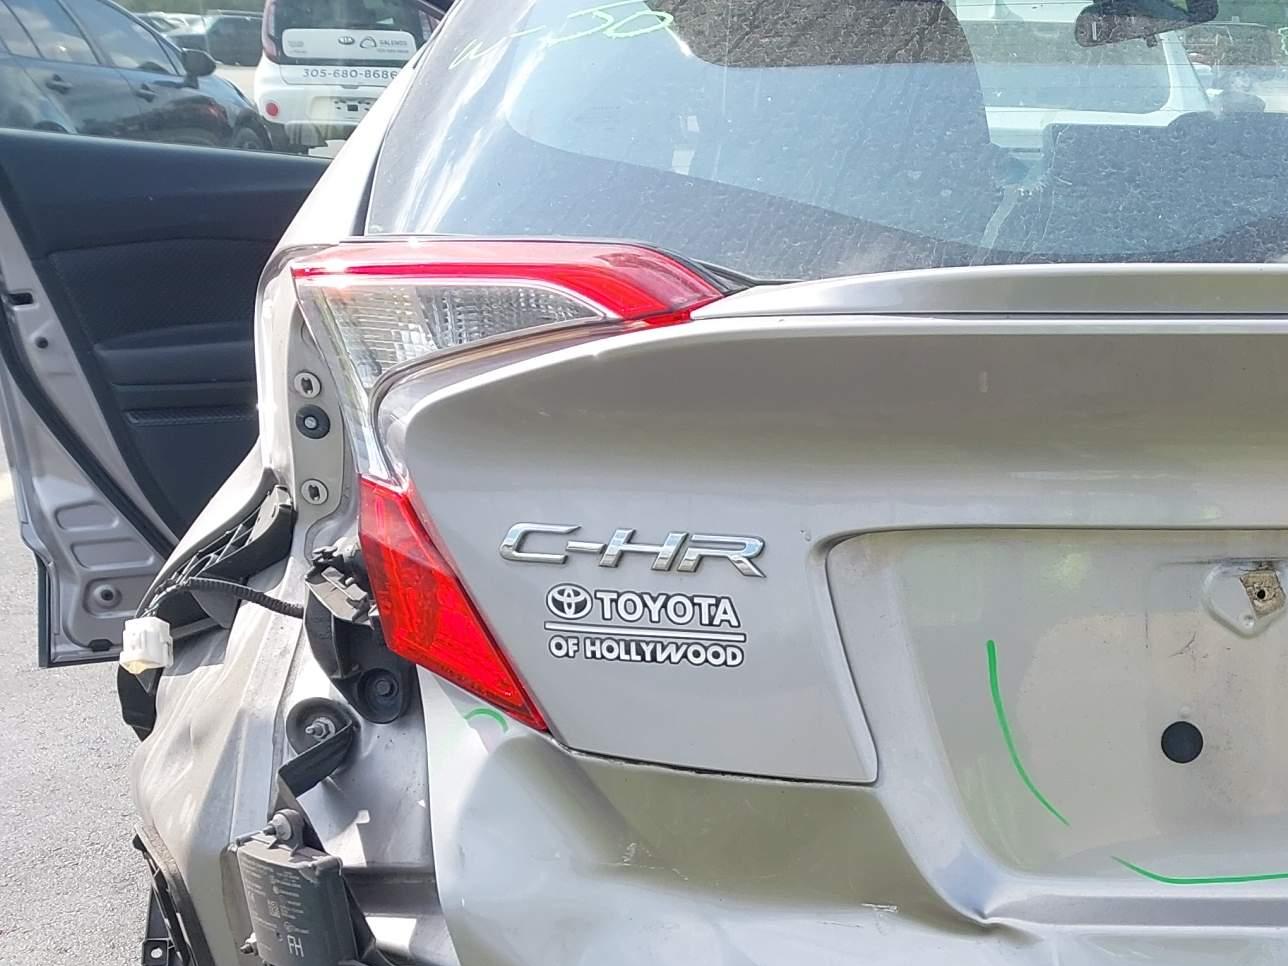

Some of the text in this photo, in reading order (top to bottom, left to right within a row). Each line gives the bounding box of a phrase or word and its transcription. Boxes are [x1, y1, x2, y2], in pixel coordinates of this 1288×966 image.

[498, 521, 768, 578] C-HR
[594, 589, 742, 628] TOYOTA
[549, 635, 745, 667] OF HOLLYWOOD
